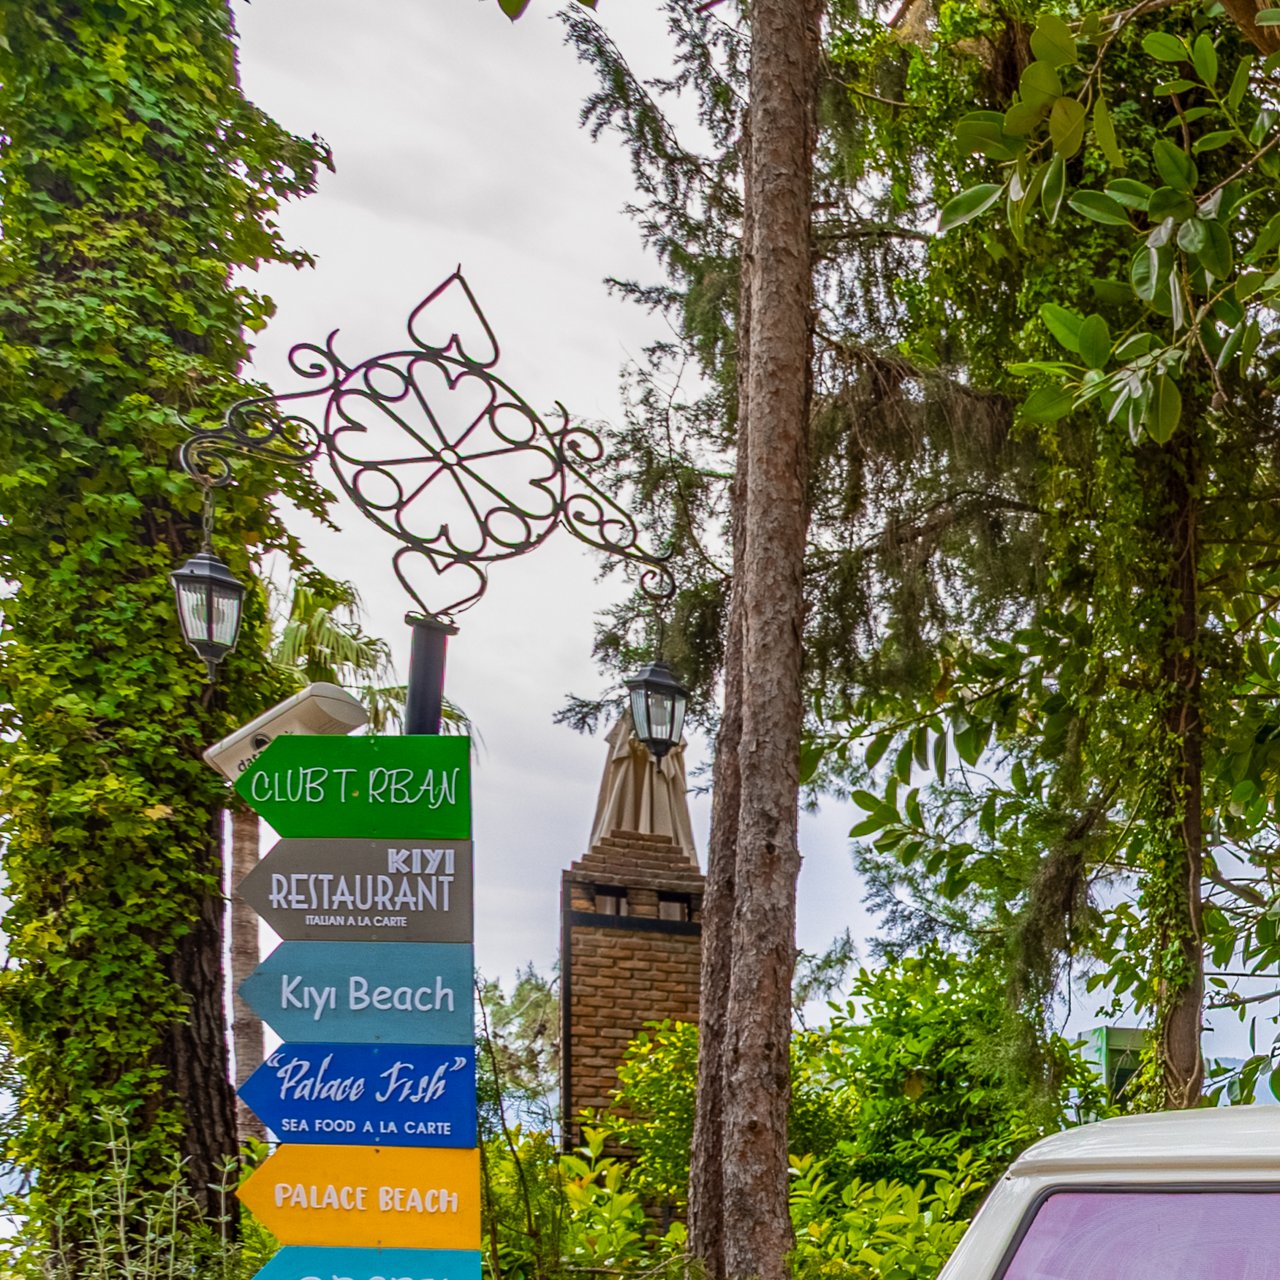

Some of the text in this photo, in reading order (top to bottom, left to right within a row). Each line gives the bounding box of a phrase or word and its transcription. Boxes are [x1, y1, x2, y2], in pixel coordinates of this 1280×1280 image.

[388, 848, 455, 874] KIYI
[269, 873, 454, 911] RESTAURANT
[305, 915, 408, 927] ITALIAN A LA CARTE
[349, 976, 456, 1012] Beach
[281, 1119, 451, 1135] SEA FOOD A LA CARTE
[274, 1183, 458, 1214] PALACE BEACH
